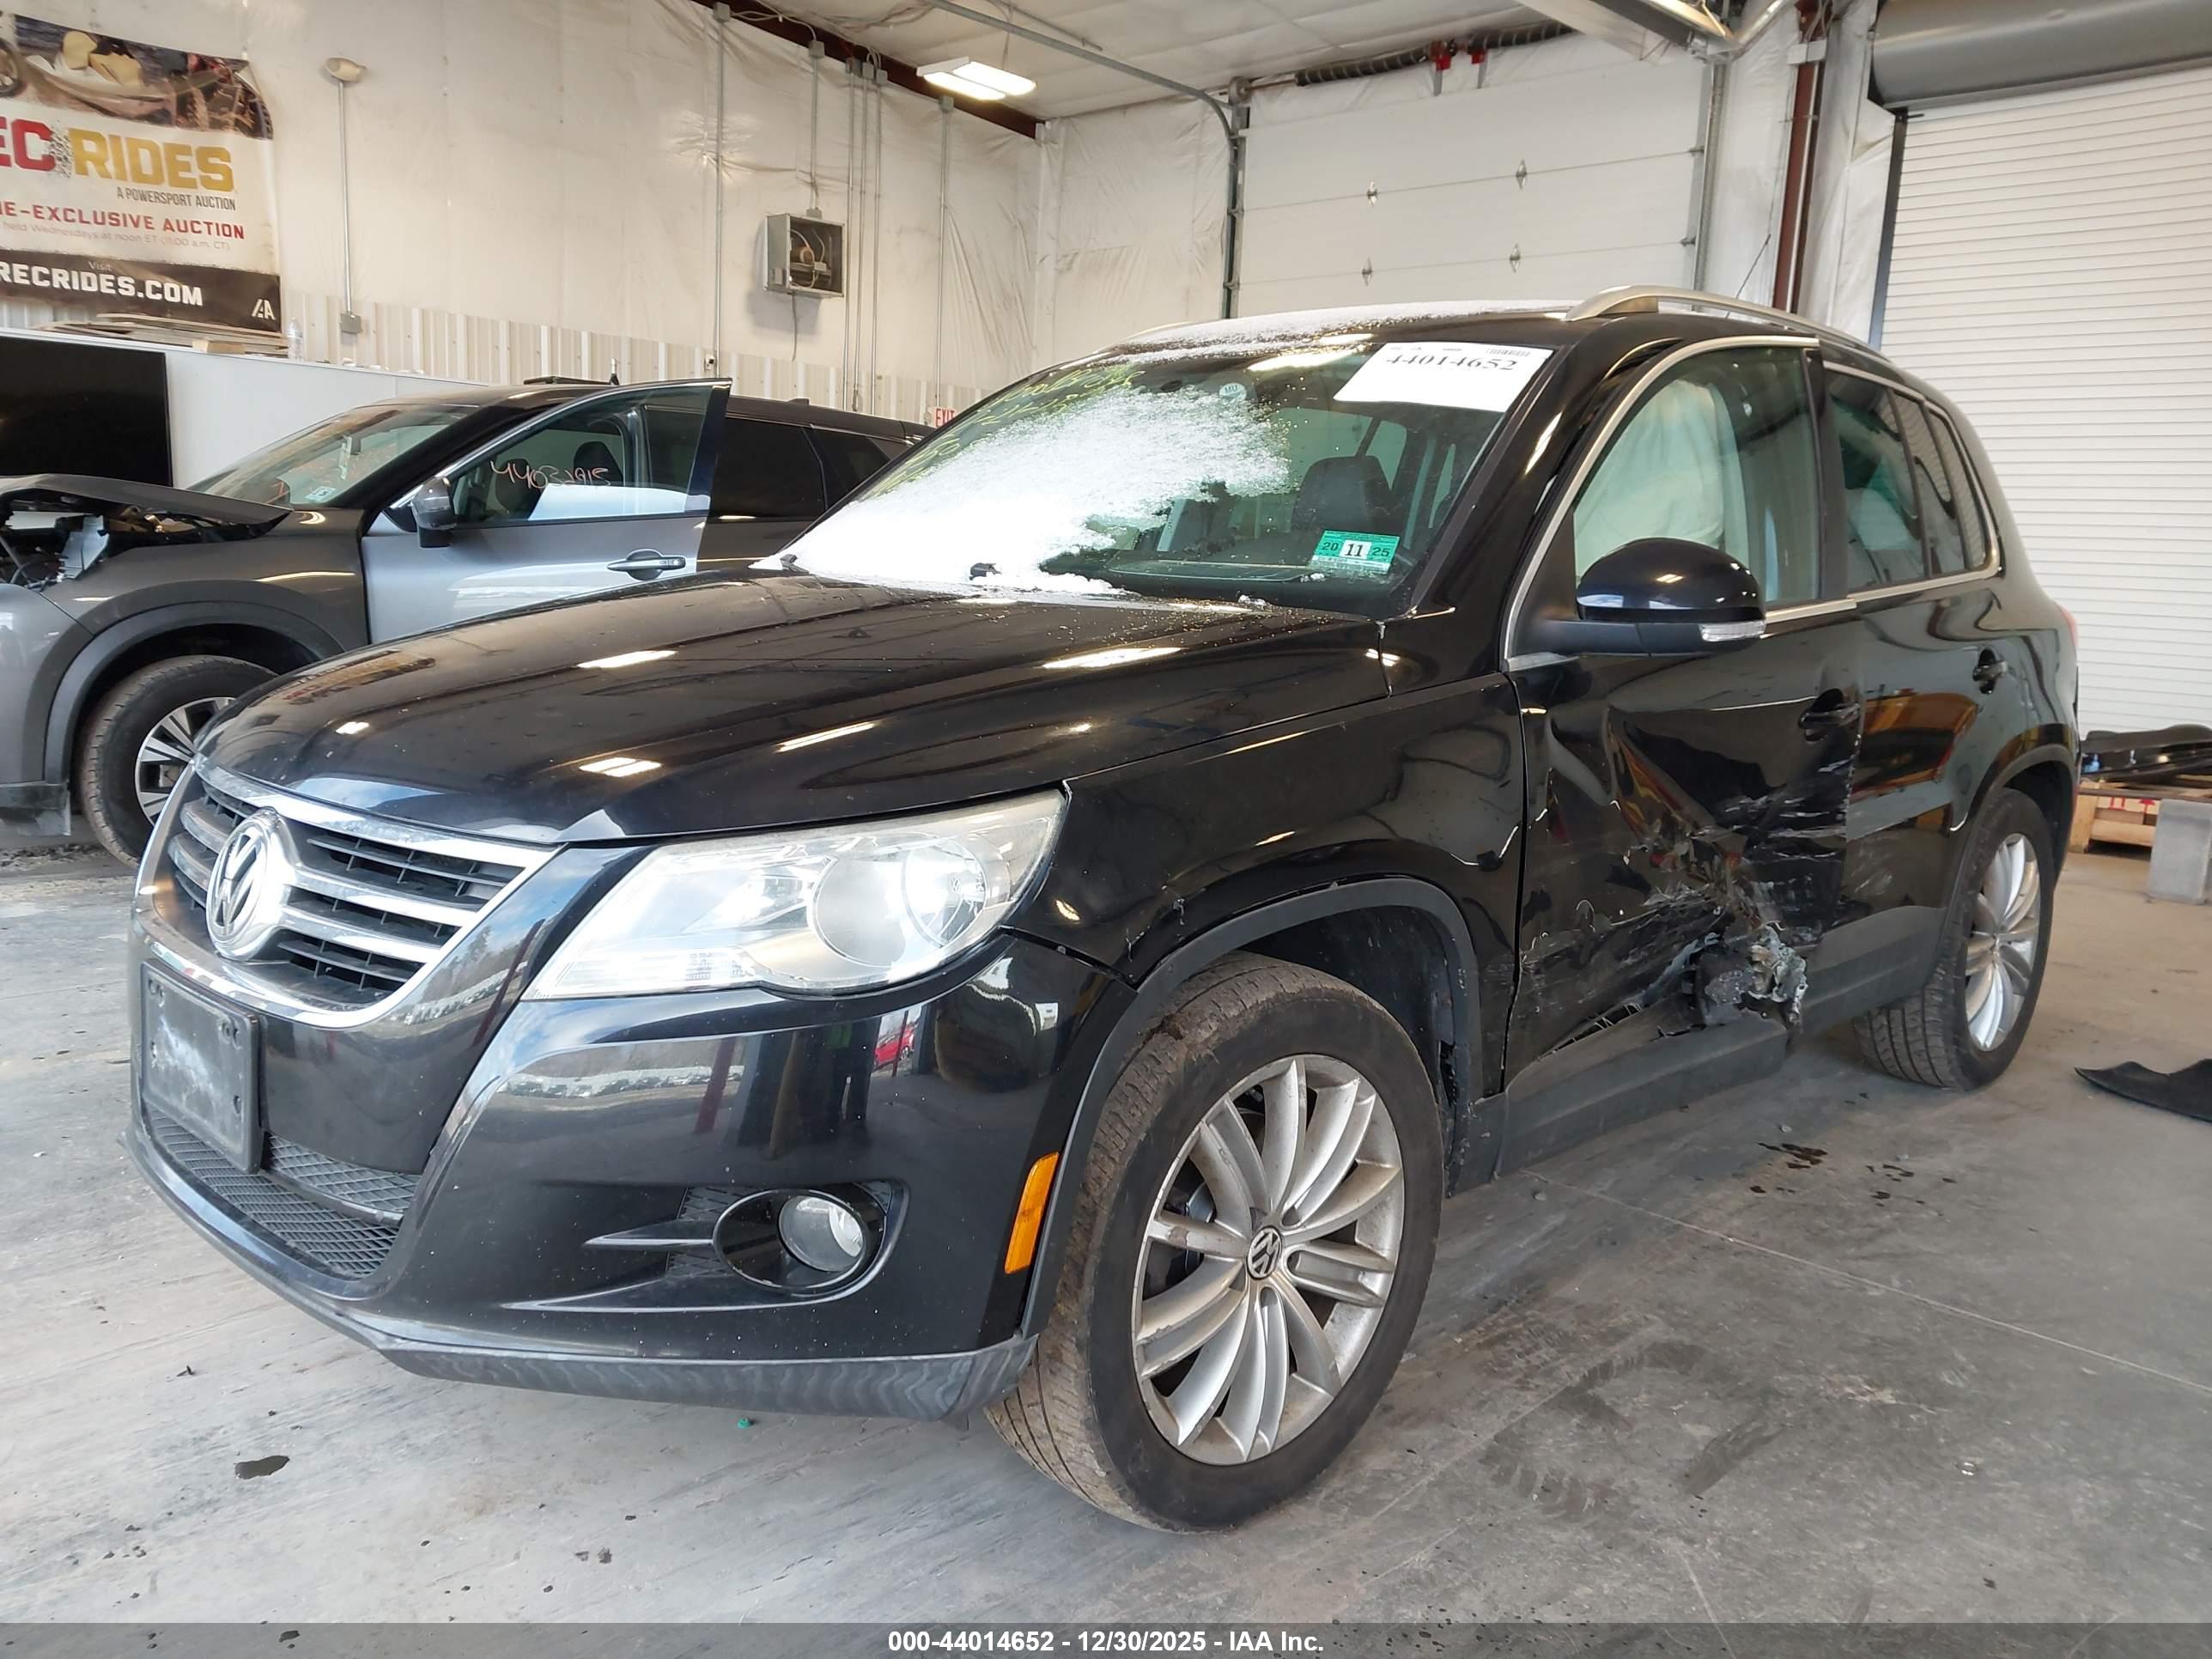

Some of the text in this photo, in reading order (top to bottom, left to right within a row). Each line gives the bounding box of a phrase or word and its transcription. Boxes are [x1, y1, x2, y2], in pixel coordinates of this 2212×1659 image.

[68, 127, 234, 192] RIDES
[117, 186, 236, 211] A POWERSPORT AUCTION
[0, 201, 245, 240] E-EXCLUSIVE AUCTION
[88, 260, 112, 272] Visit
[0, 260, 203, 307] RECRIDES.COM
[1386, 354, 1518, 371] 44014652
[1322, 542, 1390, 557] 20 11 25
